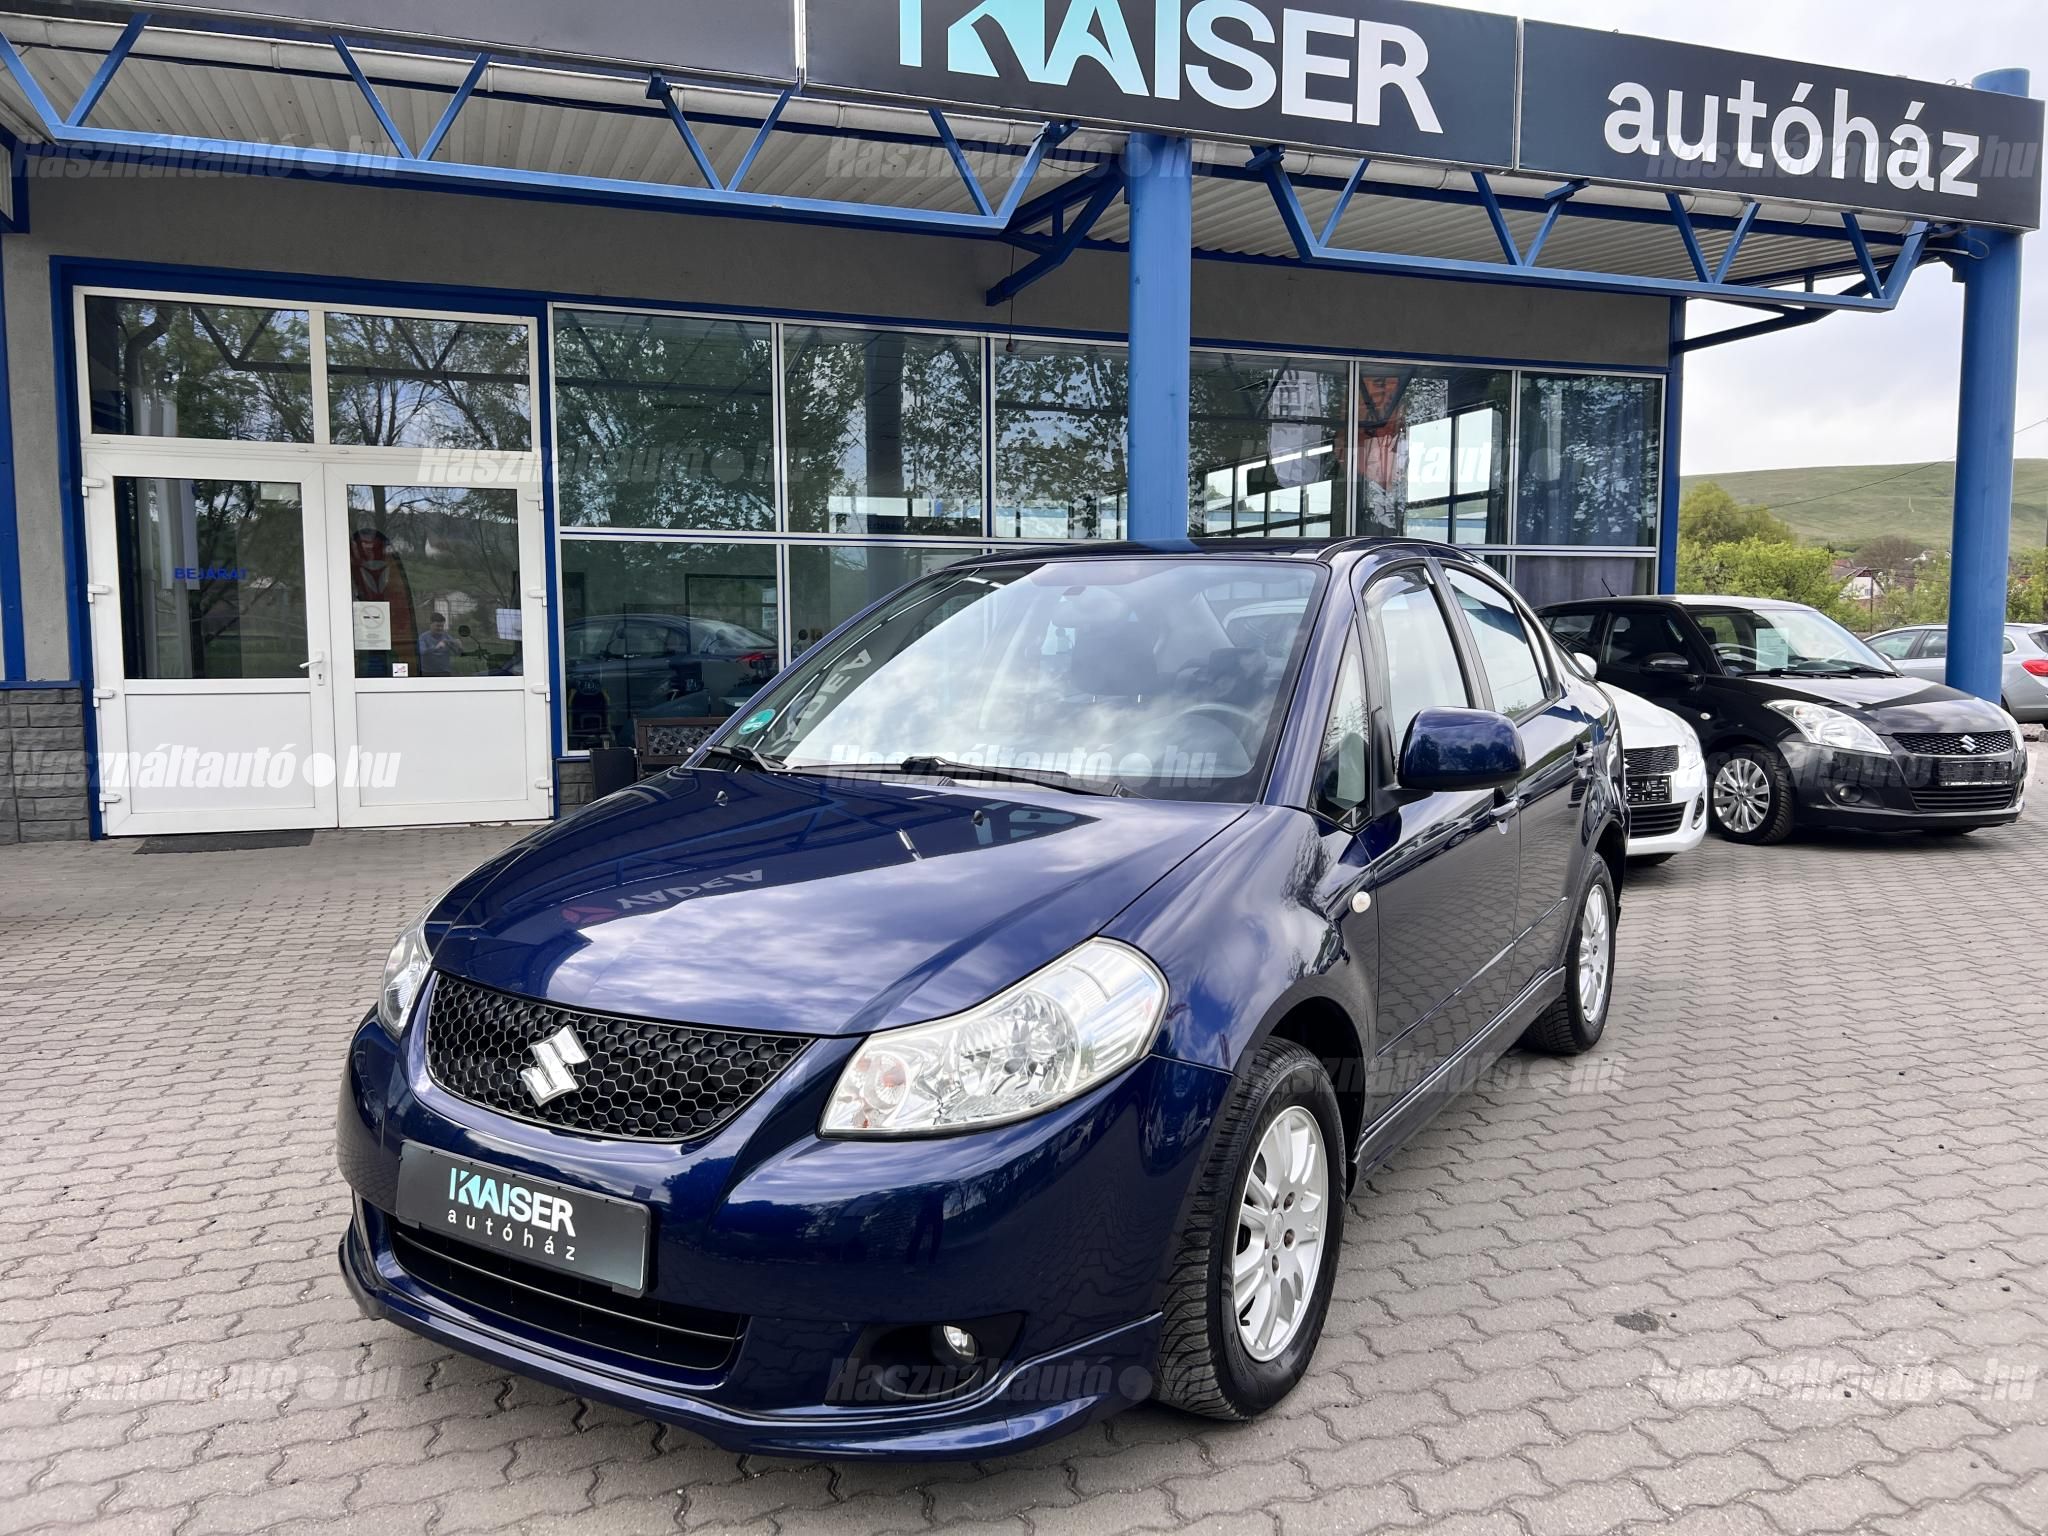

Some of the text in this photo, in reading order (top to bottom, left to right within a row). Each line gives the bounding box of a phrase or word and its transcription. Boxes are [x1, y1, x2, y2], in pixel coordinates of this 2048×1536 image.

[900, 0, 1443, 134] KAISER
[1603, 79, 1980, 197] autóház
[447, 1208, 576, 1261] autóház
[449, 1167, 576, 1237] KAISER
